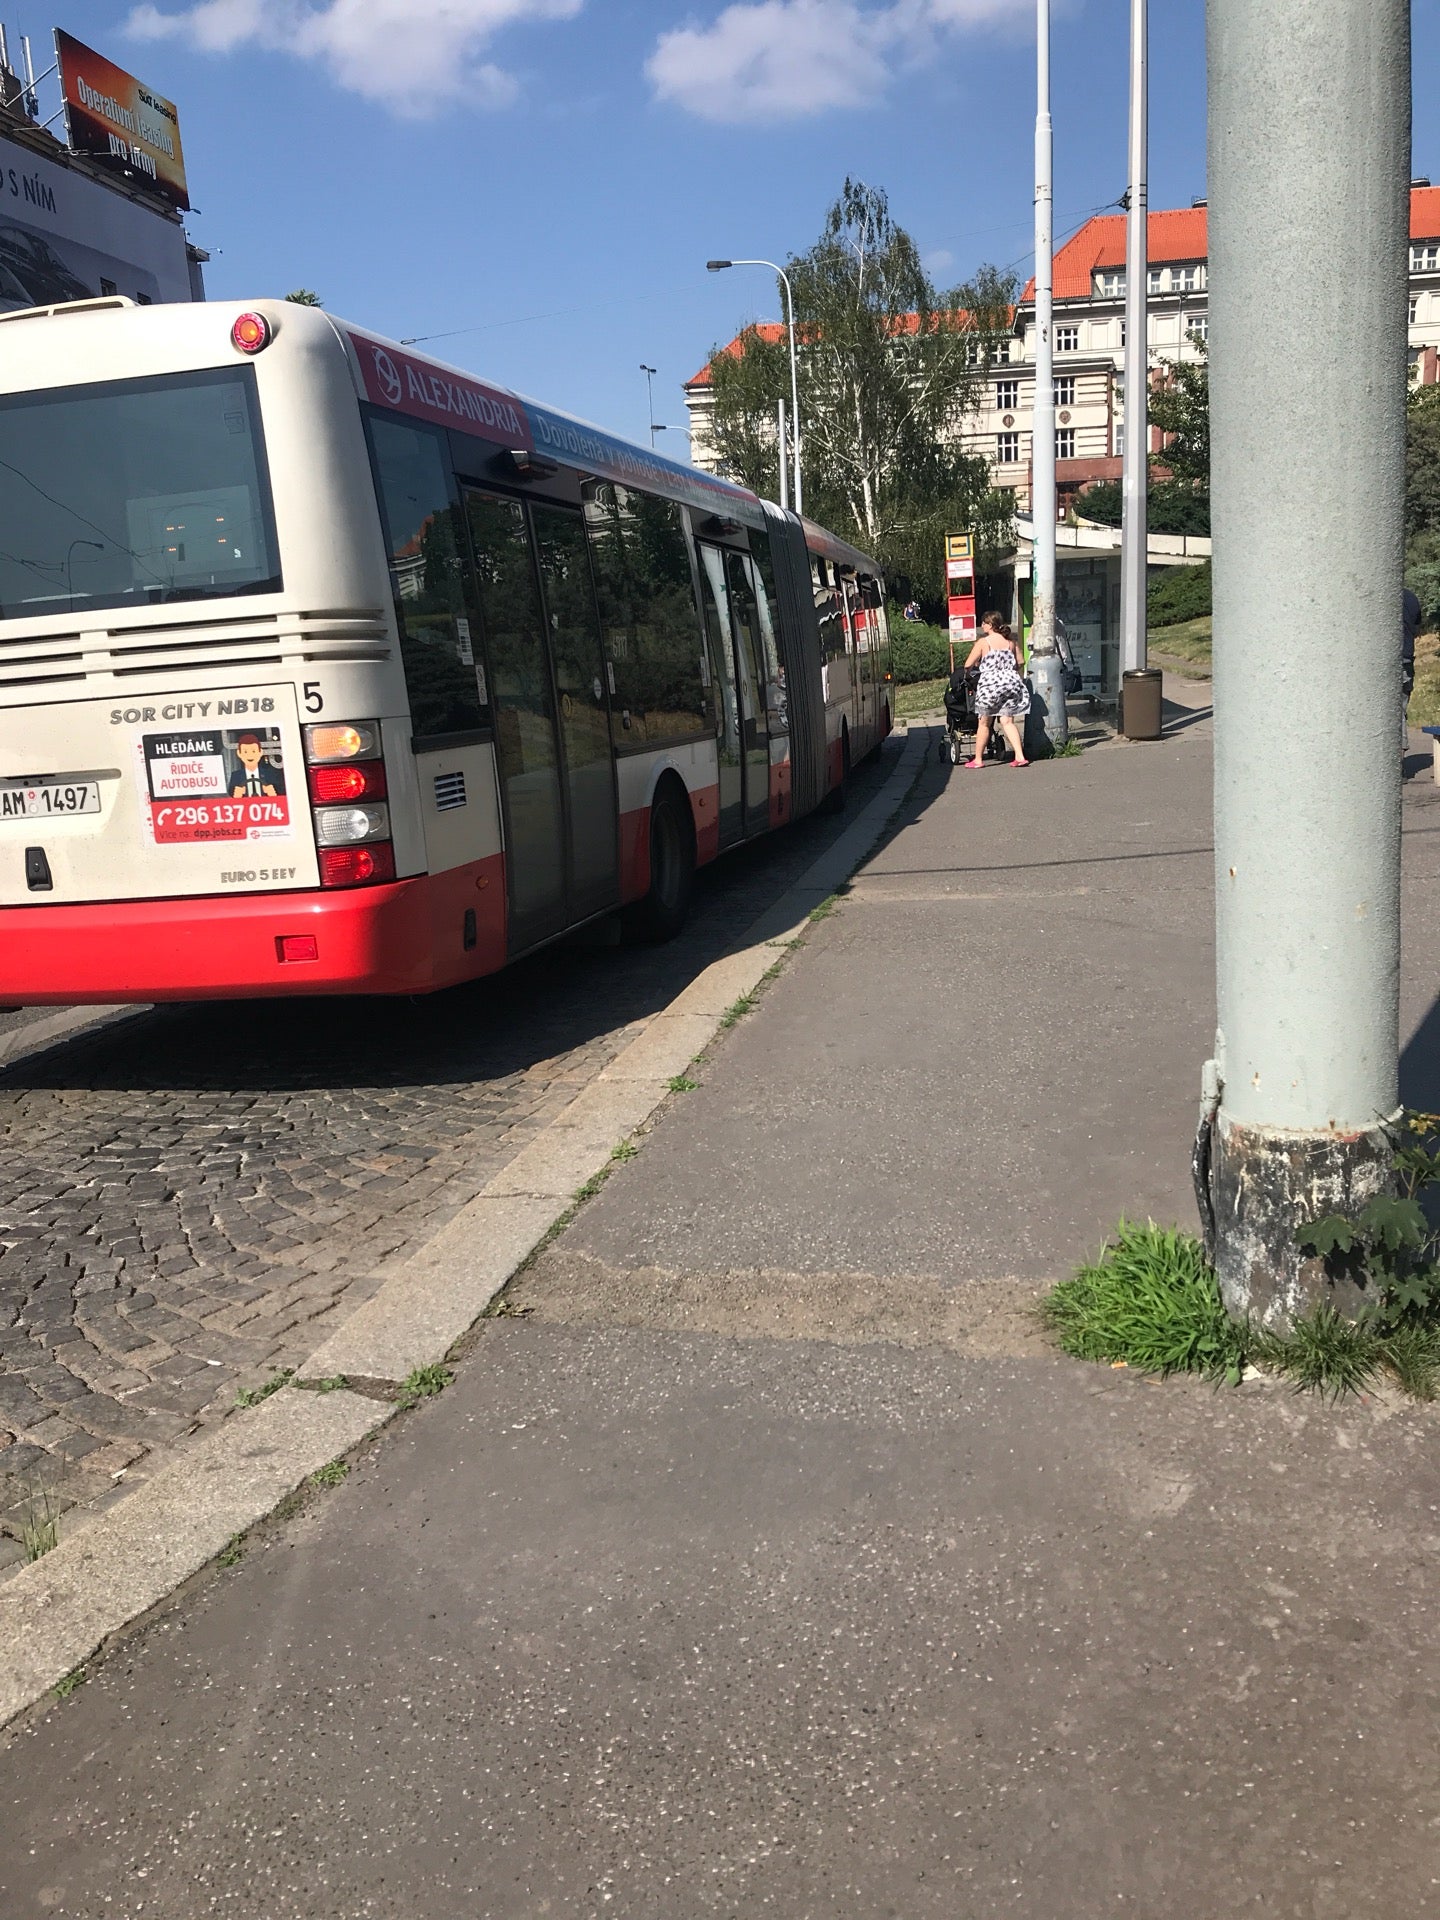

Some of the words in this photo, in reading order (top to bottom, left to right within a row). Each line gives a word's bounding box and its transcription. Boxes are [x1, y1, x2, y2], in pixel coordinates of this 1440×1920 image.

[77, 75, 136, 135] Operativní
[136, 111, 175, 160] leasing
[153, 99, 177, 125] leasing
[108, 131, 127, 160] pro
[129, 139, 157, 181] firmy
[8, 168, 19, 197] S
[22, 172, 57, 214] NÍM
[405, 364, 524, 437] ALEXANDRIA
[536, 413, 604, 462] Dovolená
[303, 681, 324, 714] 5
[110, 706, 157, 725] SOR
[161, 700, 212, 721] CITY
[155, 738, 214, 755] HLEDÁME
[170, 761, 205, 775] ŘIDIČE
[160, 776, 219, 790] AUTOBUSU
[0, 791, 26, 816] AM
[41, 786, 88, 812] 1497
[175, 806, 210, 826] 296
[212, 804, 245, 824] 137
[248, 803, 285, 822] 074
[220, 870, 257, 884] EURO
[259, 868, 270, 881] 5
[272, 867, 297, 881] EEV
